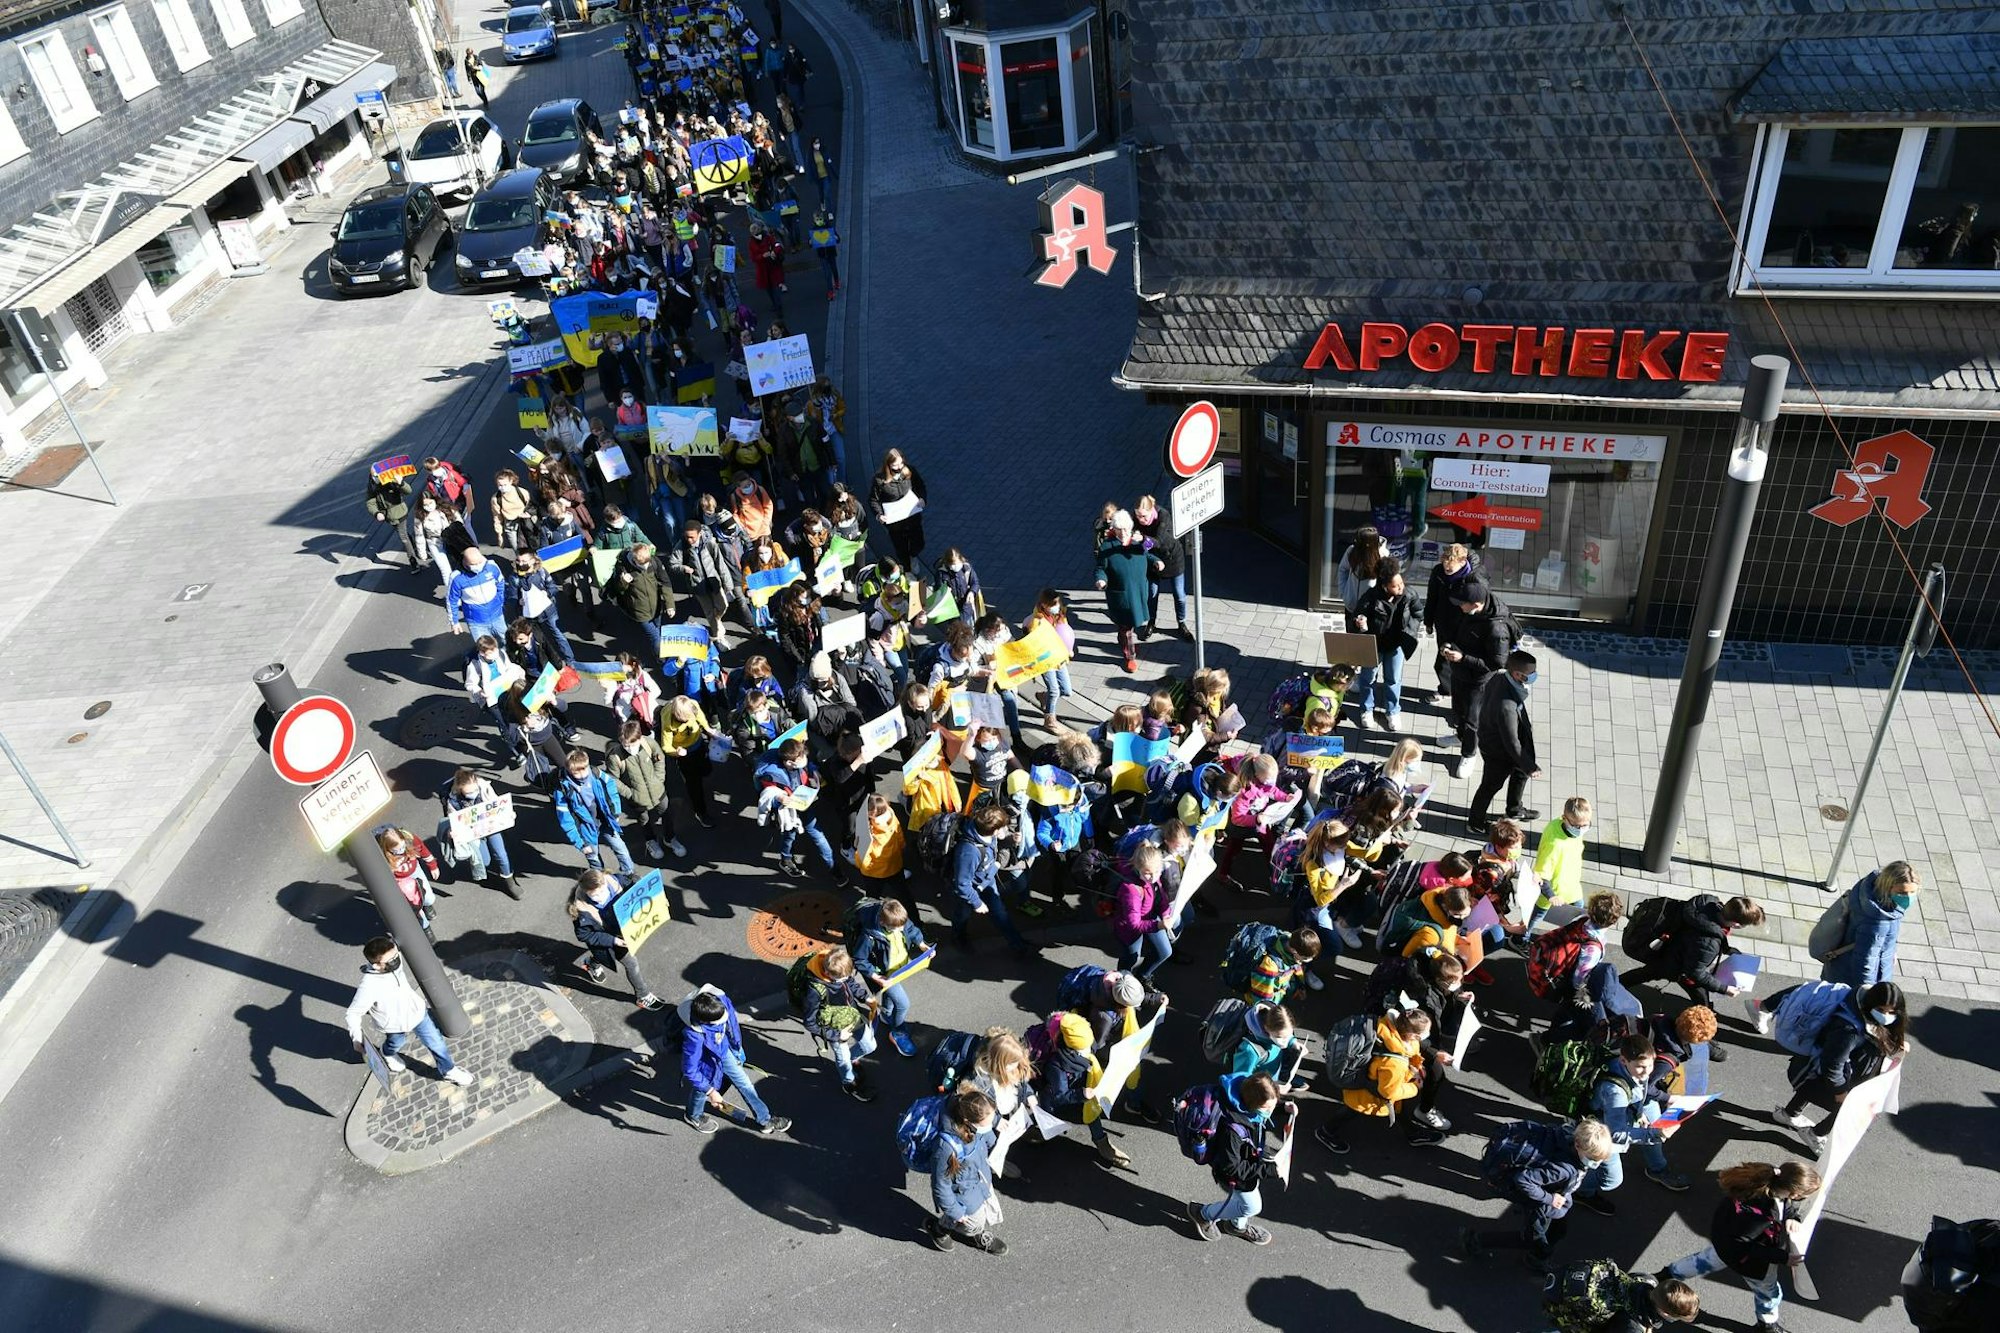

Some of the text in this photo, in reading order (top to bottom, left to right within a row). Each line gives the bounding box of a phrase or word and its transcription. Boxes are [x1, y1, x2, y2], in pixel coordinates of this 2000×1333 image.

[1303, 322, 1730, 382] APOTHEKE
[1370, 426, 1446, 446] Cosmas
[1455, 432, 1616, 455] APOTHEKE
[1471, 463, 1511, 478] Hier:
[1181, 477, 1214, 501] Linien-
[1433, 477, 1545, 494] Corona-Teststation
[1180, 487, 1216, 515] verkehr
[1441, 508, 1537, 525] Zur Corona-Teststation
[316, 769, 362, 808] Linien-
[321, 779, 371, 822] verkehr
[630, 914, 660, 942] WAR
